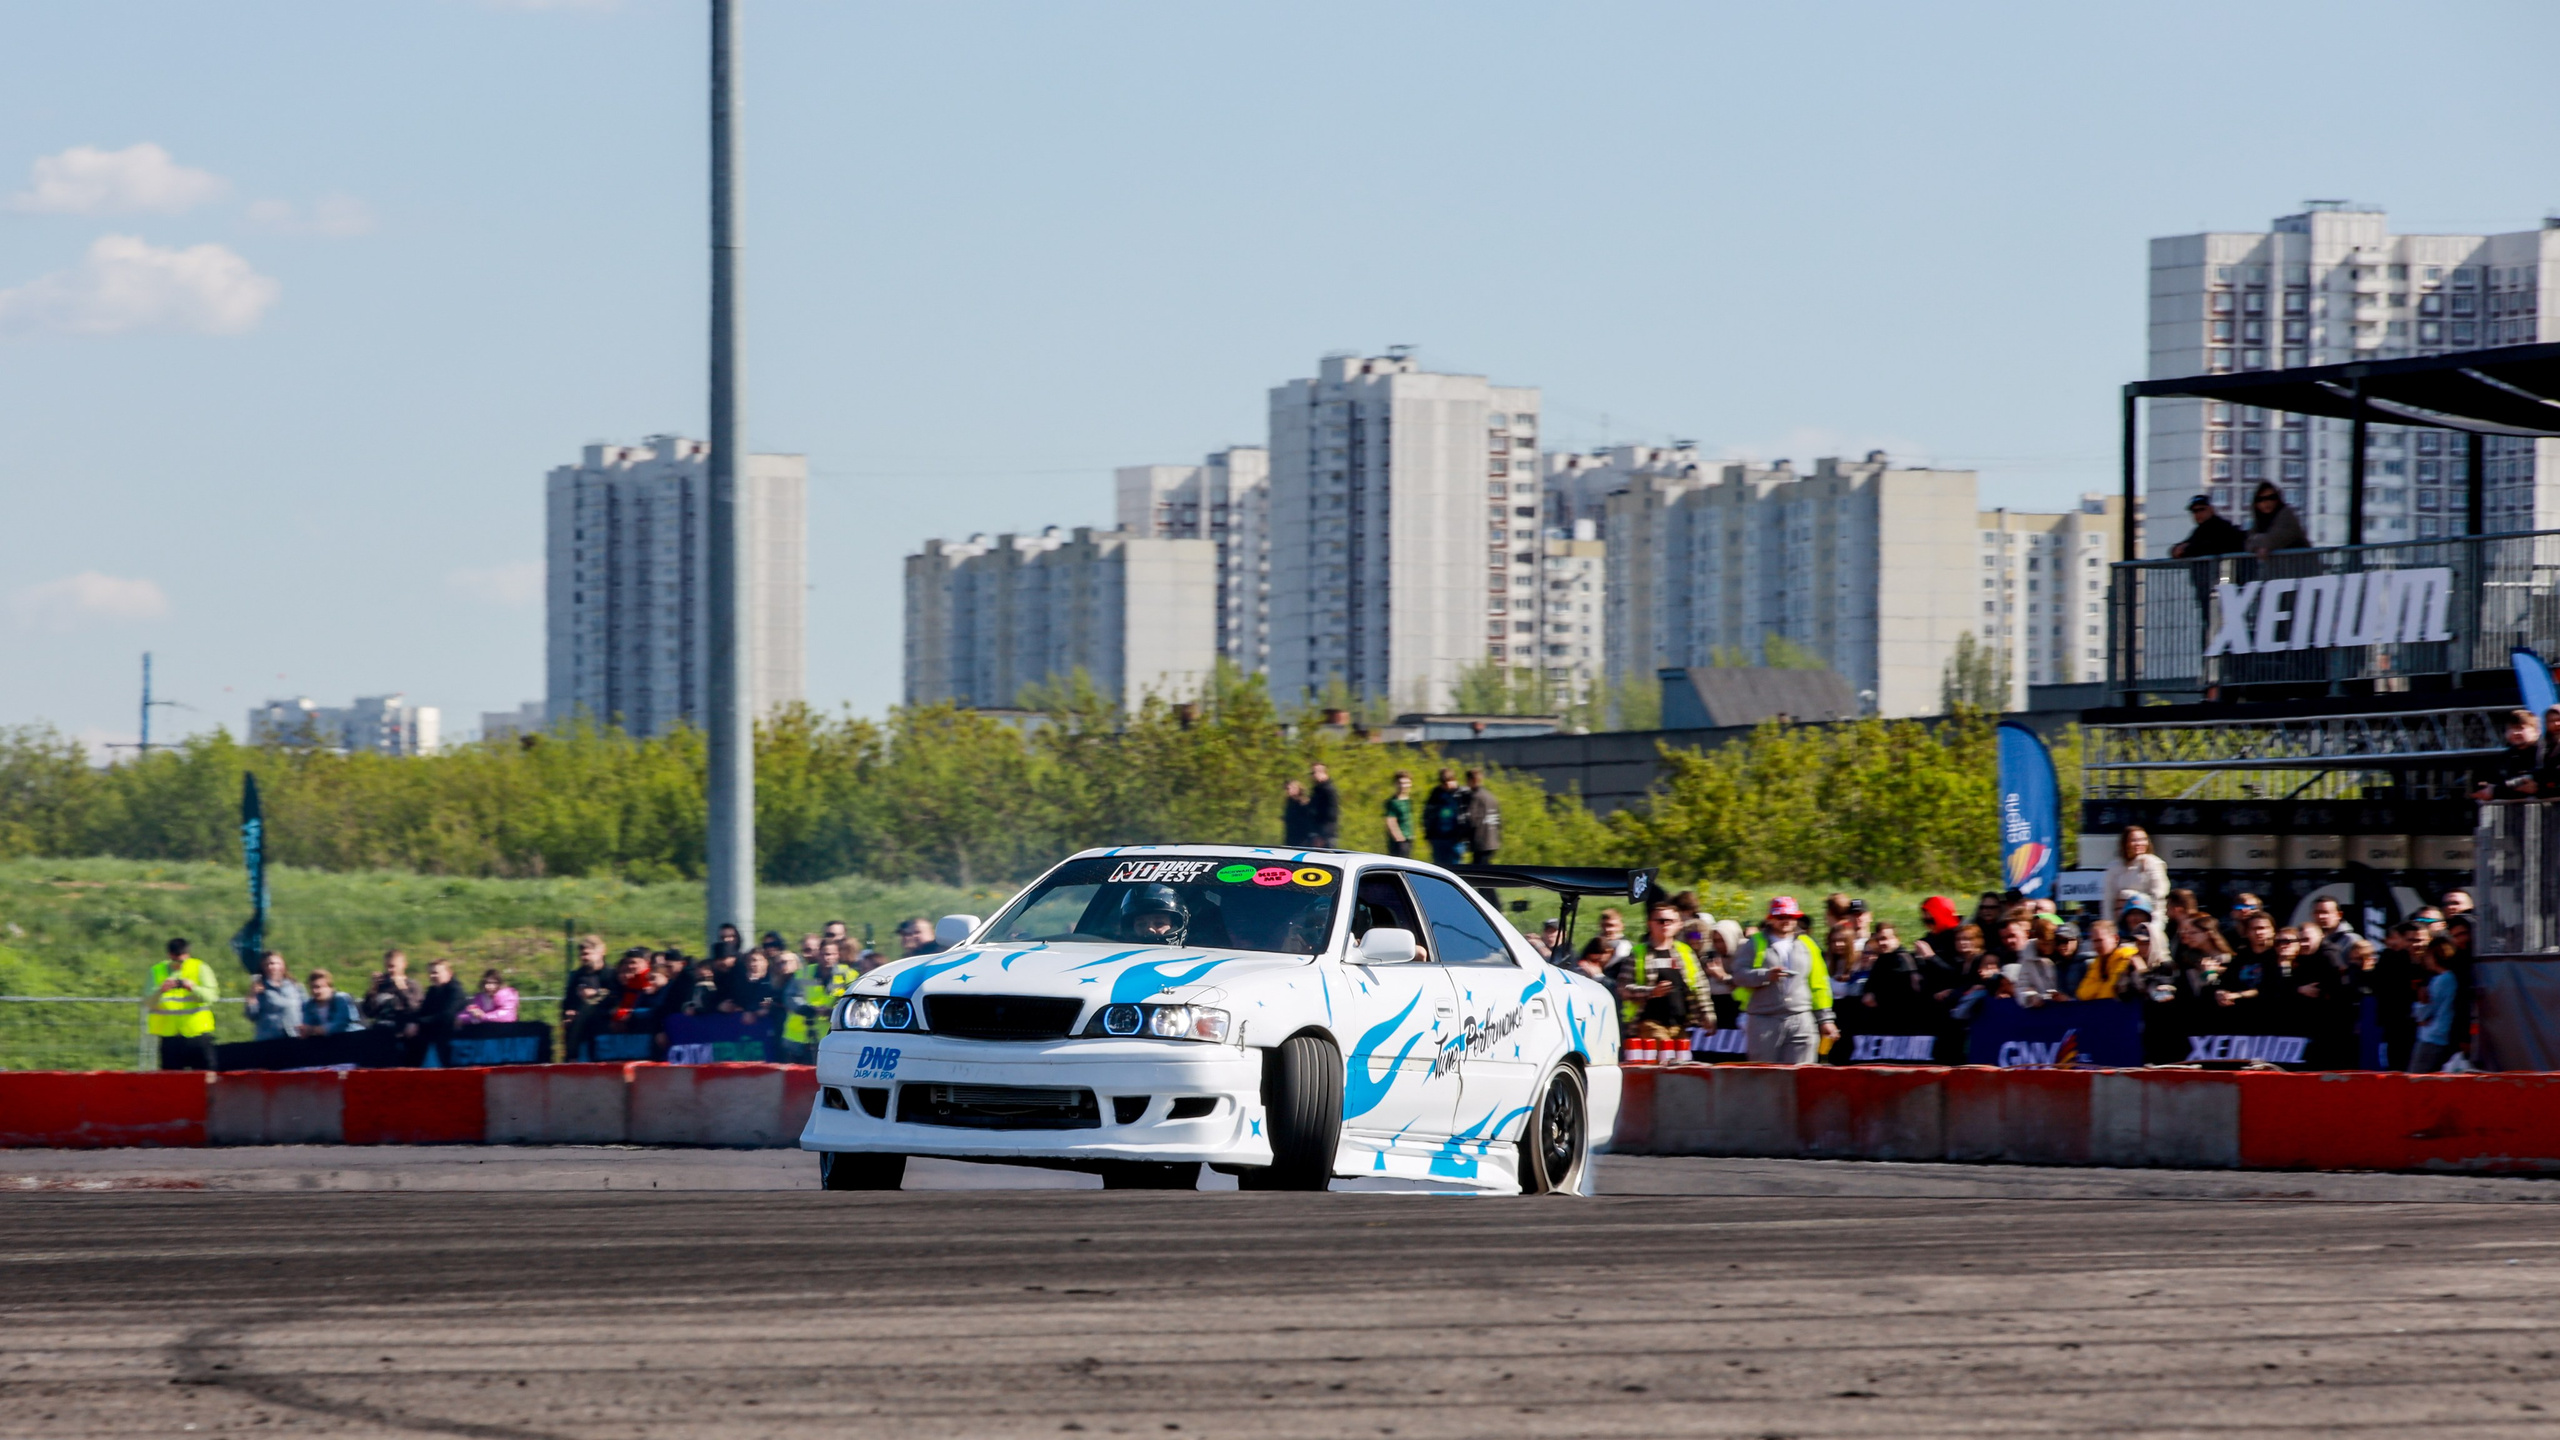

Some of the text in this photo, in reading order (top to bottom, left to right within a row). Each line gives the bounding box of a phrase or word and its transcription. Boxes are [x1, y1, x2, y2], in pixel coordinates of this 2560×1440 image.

[2203, 567, 2452, 657] XENUM
[1150, 871, 1202, 882] FEST
[1160, 861, 1219, 872] DRIFT
[1463, 1005, 1523, 1065] Performance
[857, 1046, 902, 1071] DNB
[2187, 1035, 2310, 1063] XENUM
